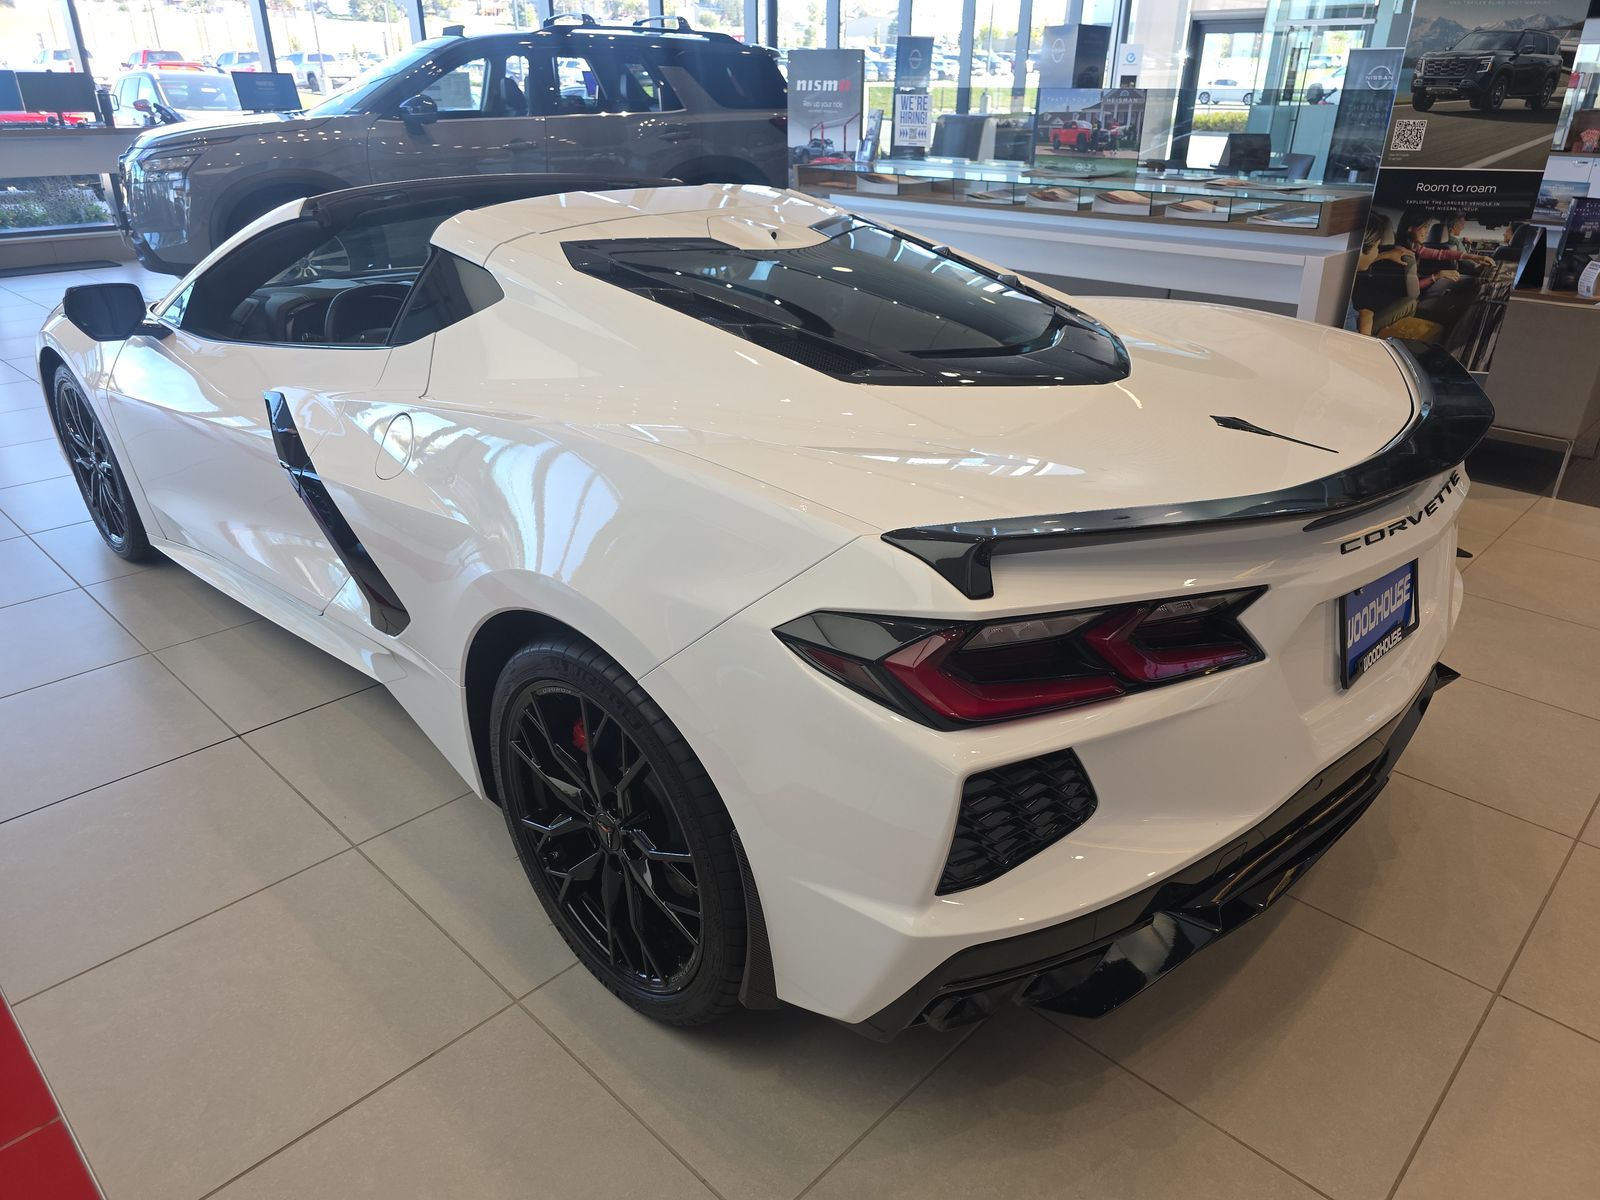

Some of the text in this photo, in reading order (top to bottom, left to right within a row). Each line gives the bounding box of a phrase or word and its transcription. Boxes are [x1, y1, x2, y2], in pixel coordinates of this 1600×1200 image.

[900, 95, 928, 111] WE'RE
[900, 111, 928, 125] HIRING!
[1416, 182, 1497, 193] Room to roam
[1340, 469, 1461, 555] CORVETTE
[1363, 626, 1402, 672] WOODHOUSE
